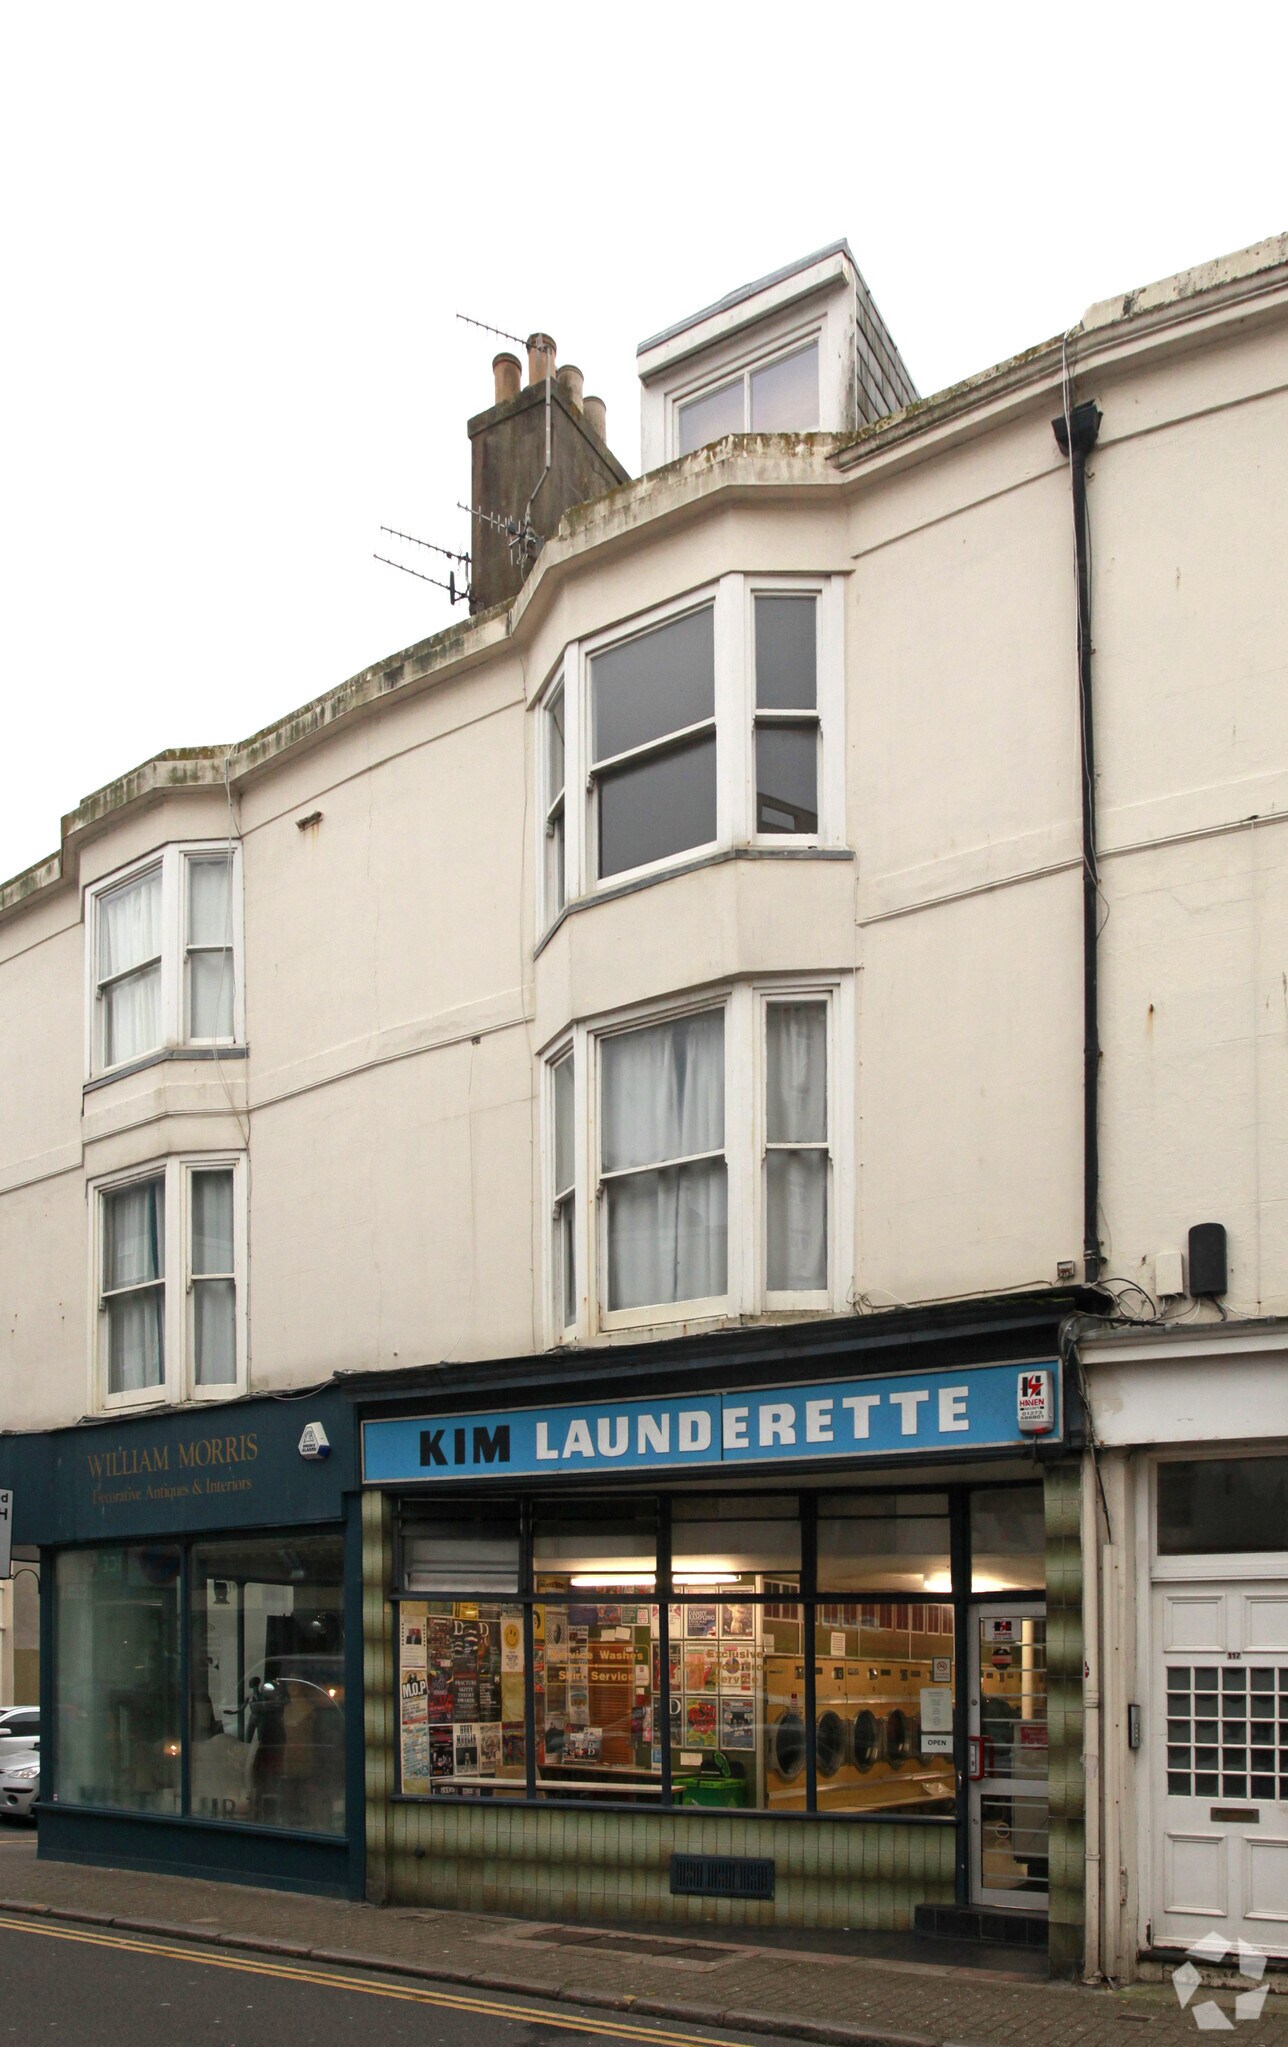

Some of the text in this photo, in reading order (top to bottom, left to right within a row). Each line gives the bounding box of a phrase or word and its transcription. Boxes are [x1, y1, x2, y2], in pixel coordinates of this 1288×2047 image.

[1020, 1398, 1044, 1407] HAVEN
[419, 1386, 970, 1467] KIM LAUNDERETTE
[87, 1433, 258, 1478] WILLIAM MORRIS
[93, 1477, 252, 1504] Decorative Antiques & Interiors
[550, 1650, 643, 1660] Service Washes
[706, 1649, 763, 1659] Exclusive
[591, 1671, 636, 1680] Service
